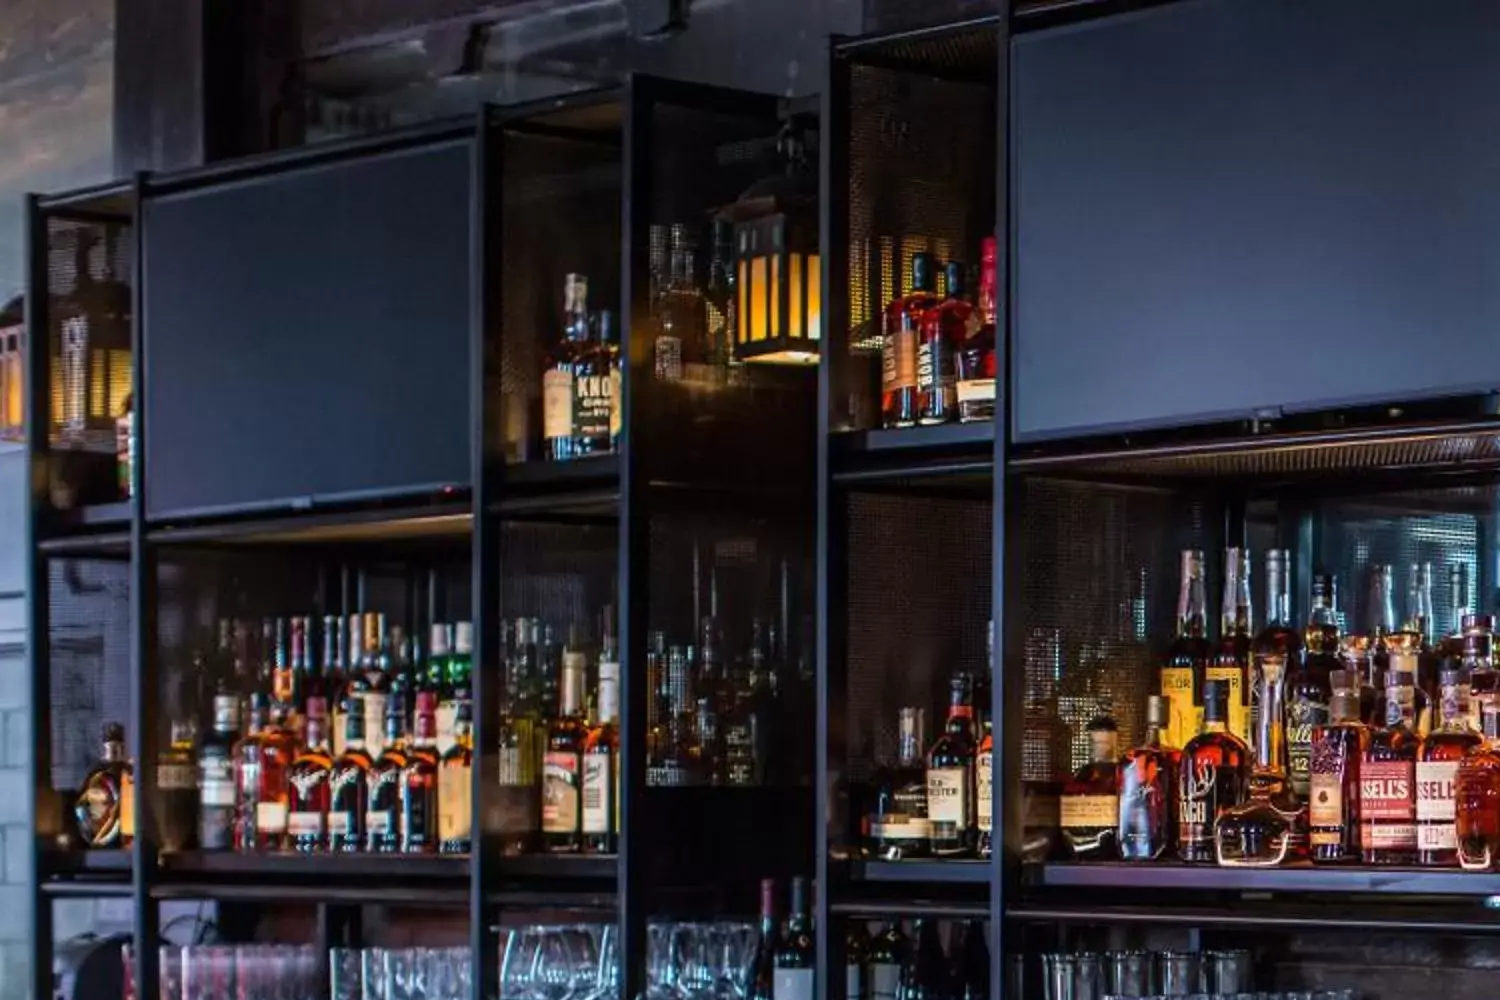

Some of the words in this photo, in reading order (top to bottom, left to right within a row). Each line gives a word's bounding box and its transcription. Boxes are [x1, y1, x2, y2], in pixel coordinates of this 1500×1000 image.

[577, 376, 611, 398] KNO
[1295, 757, 1308, 771] 12
[1417, 781, 1456, 799] SELL
